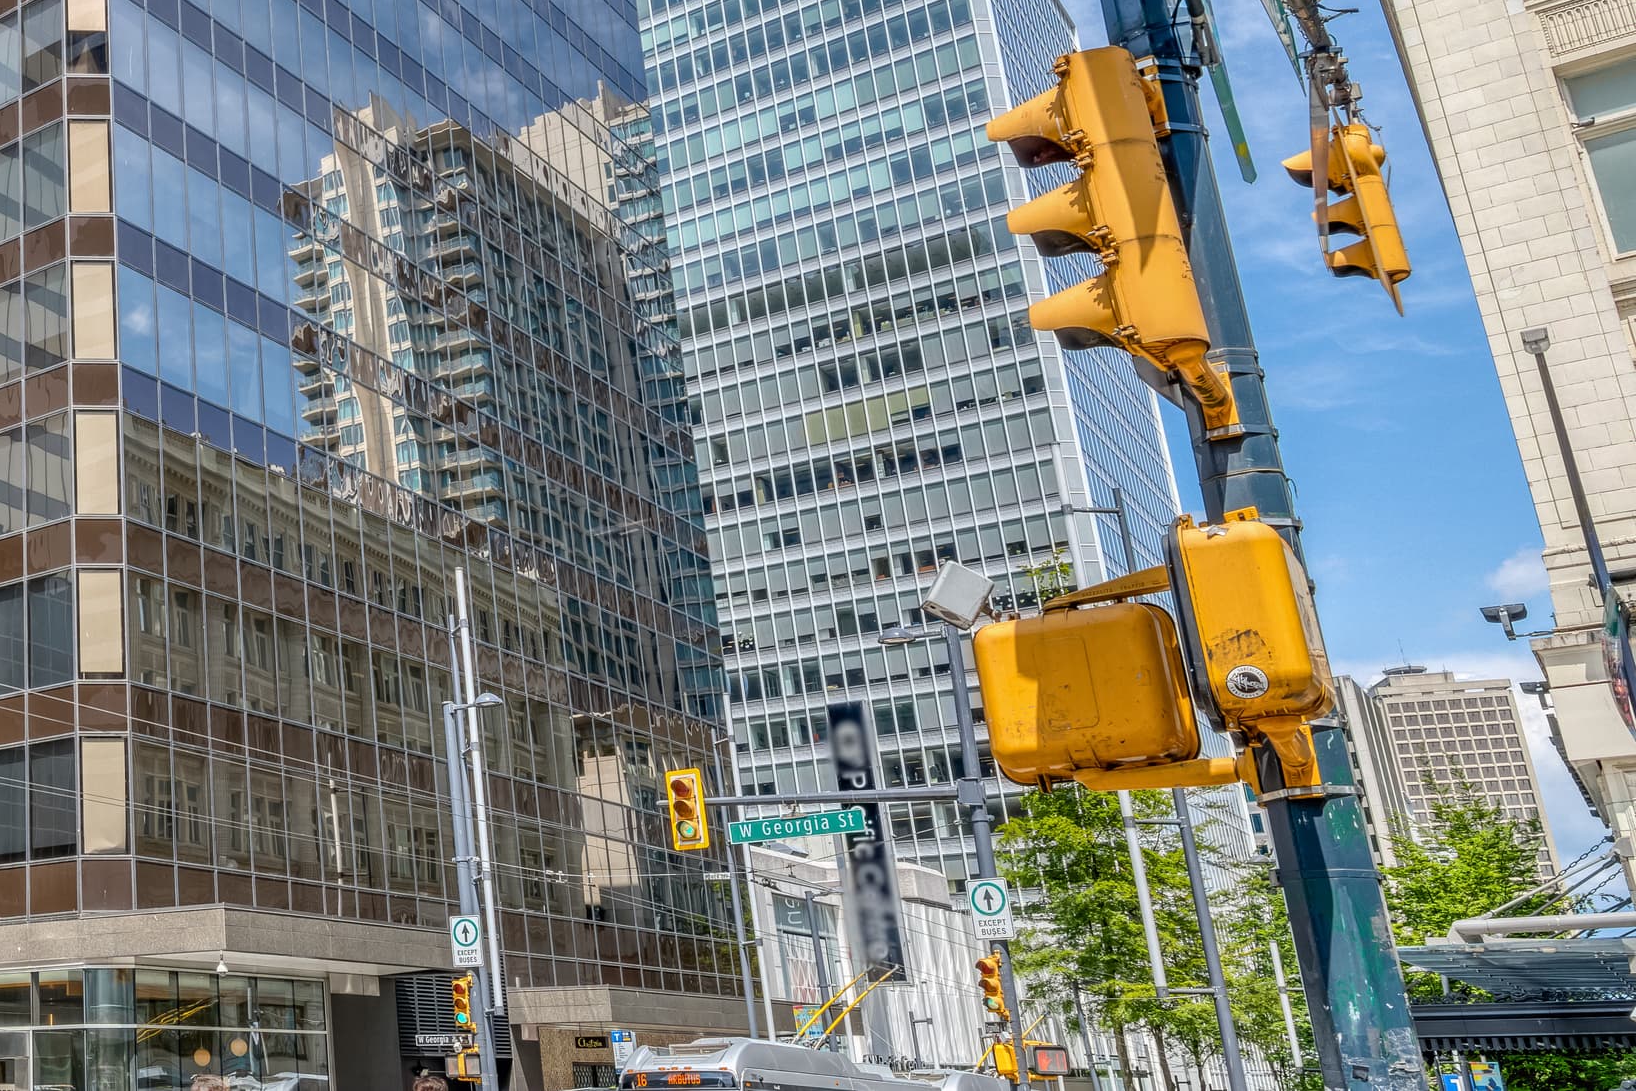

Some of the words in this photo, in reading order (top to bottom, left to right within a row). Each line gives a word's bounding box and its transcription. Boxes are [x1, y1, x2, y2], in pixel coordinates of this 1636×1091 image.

[739, 824, 752, 838] W
[761, 819, 830, 836] Georgia
[838, 812, 855, 828] St
[978, 919, 1007, 928] EXCEPT
[981, 927, 1007, 937] BUSES
[458, 956, 477, 964] BUSES
[418, 1036, 424, 1044] W
[425, 1036, 449, 1046] Georgia
[636, 1073, 647, 1087] 16
[668, 1073, 701, 1085] ARBUTUS
